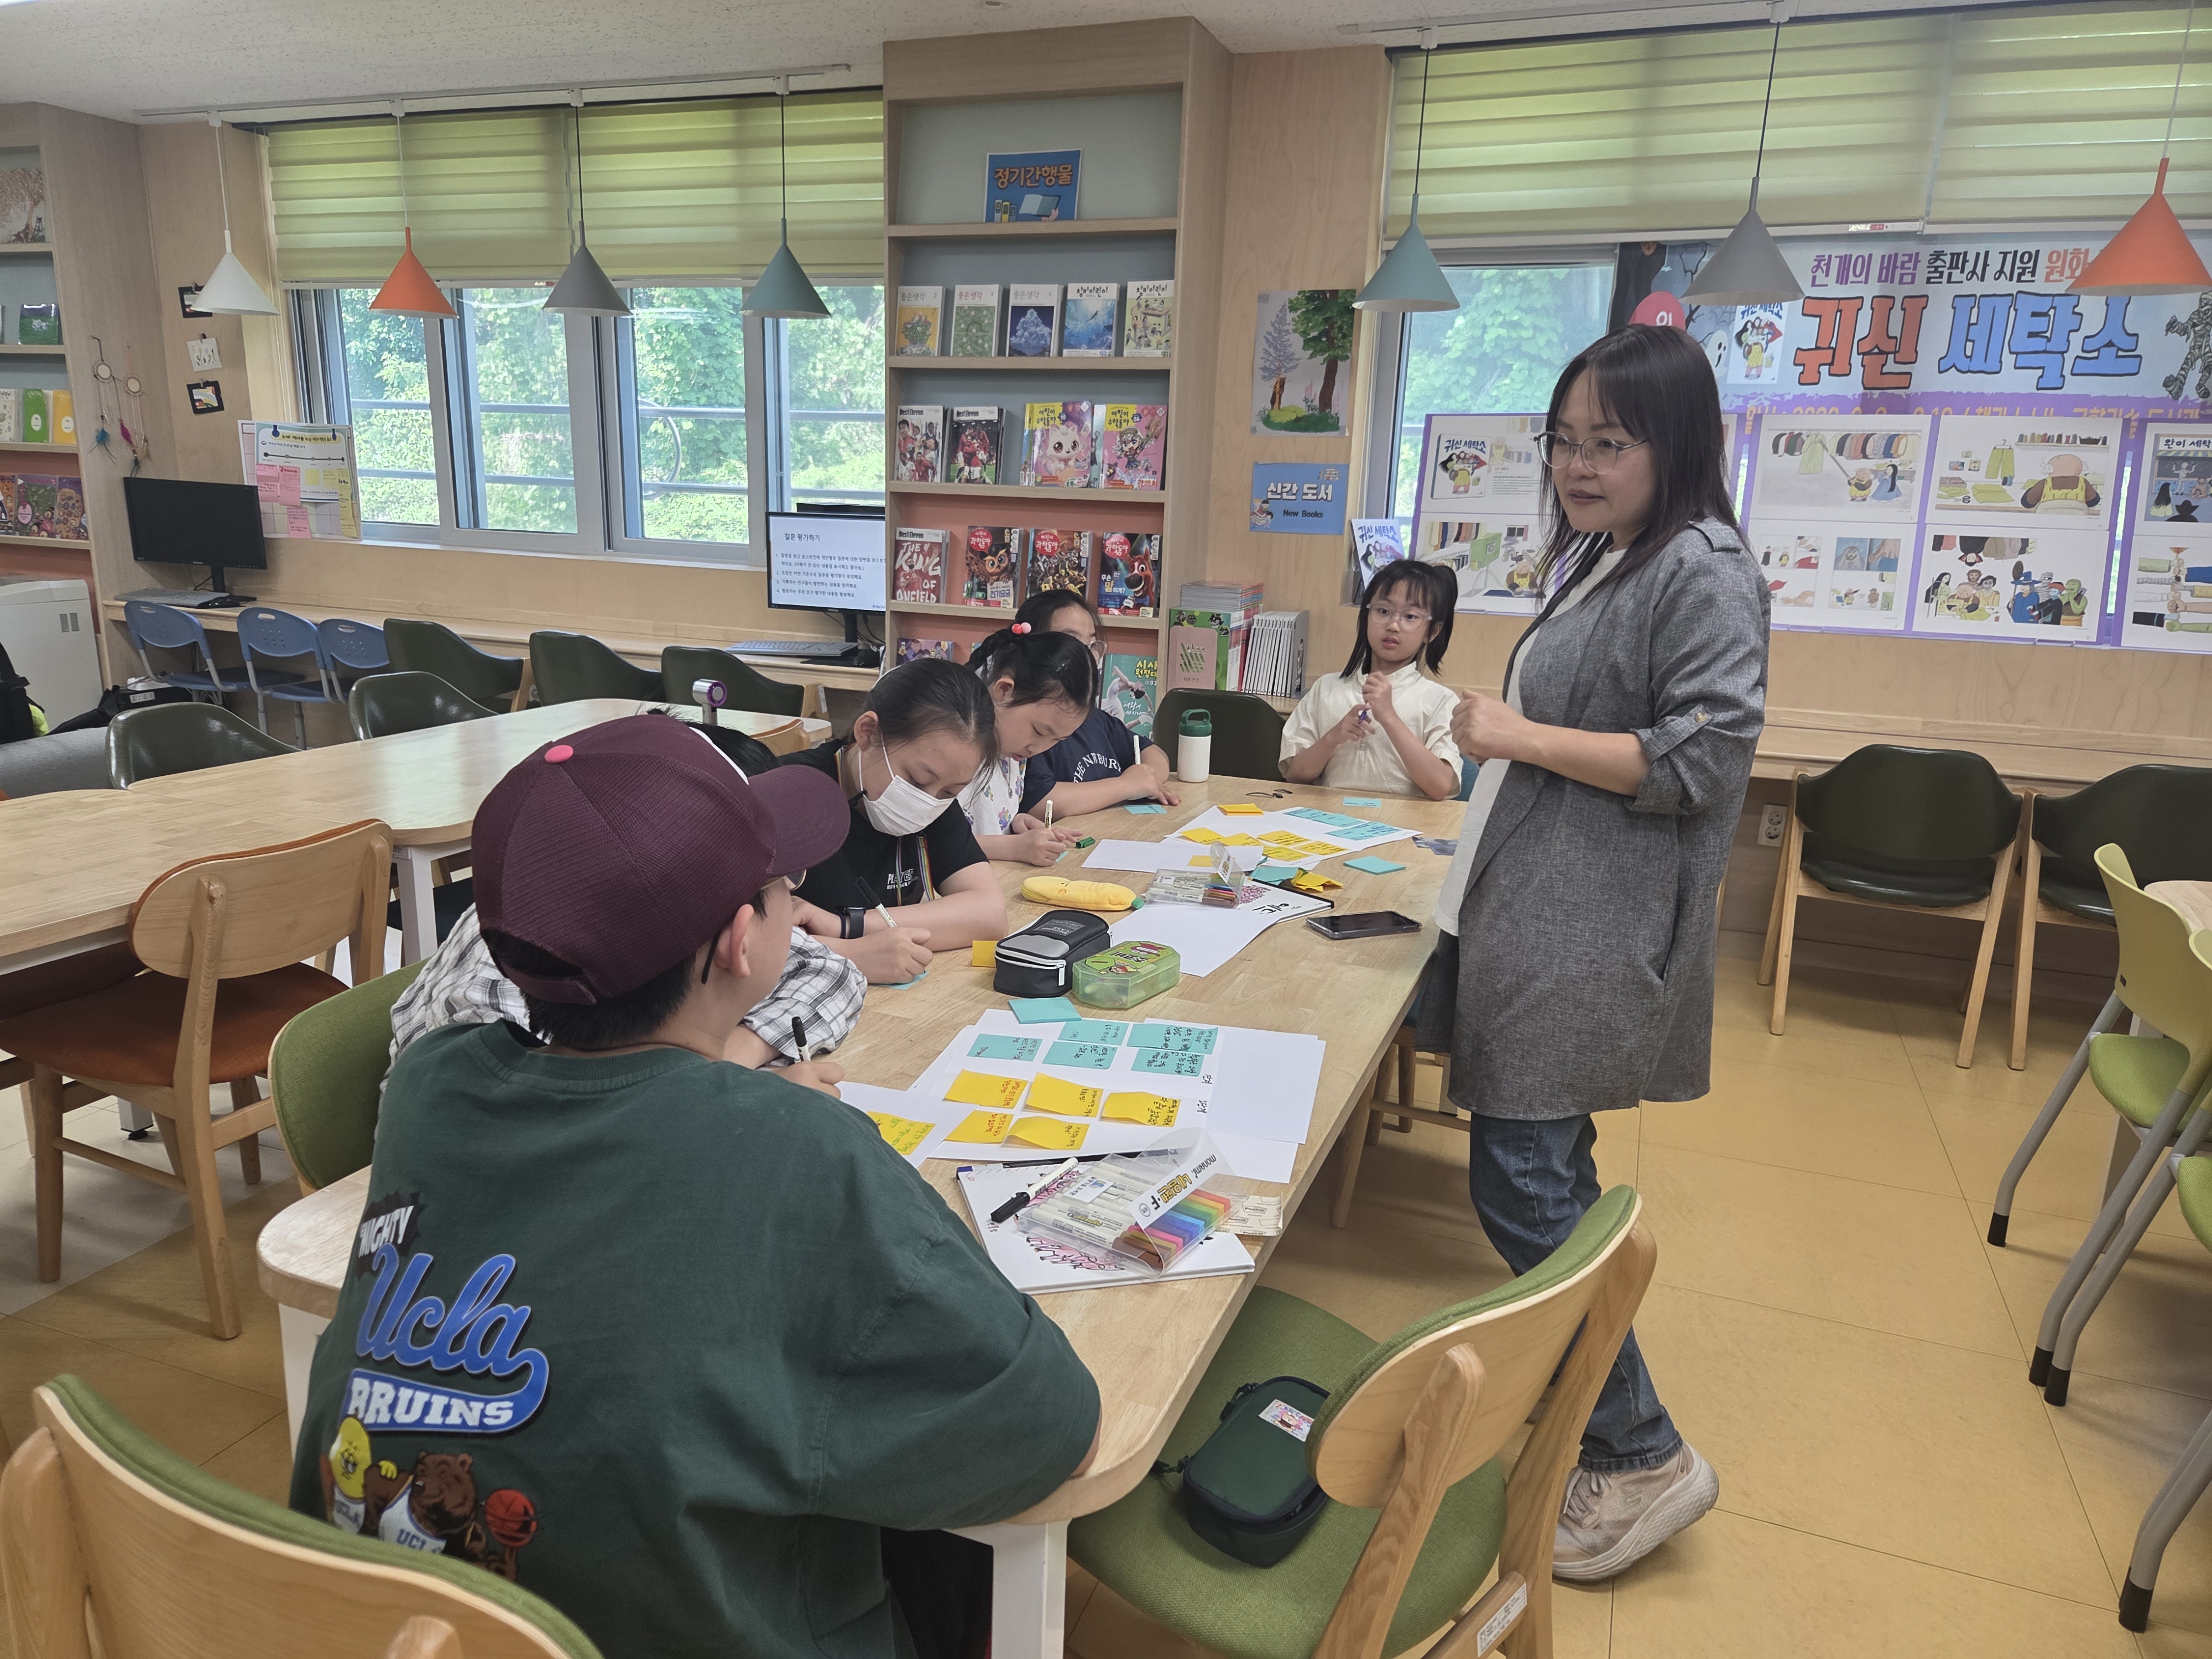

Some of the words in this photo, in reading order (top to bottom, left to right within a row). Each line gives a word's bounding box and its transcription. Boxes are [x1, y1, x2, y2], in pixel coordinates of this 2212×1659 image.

[993, 164, 1073, 189] 정기간행물
[1810, 253, 1872, 288] 천개의
[1876, 252, 1921, 285] 바람
[1926, 250, 1990, 284] 출판사
[1994, 249, 2040, 283] 지원
[2044, 248, 2091, 283] 원화
[958, 291, 982, 301] 좋은생각
[1013, 290, 1040, 301] 좋은생각
[1076, 285, 1108, 298] 창비어린이
[1136, 284, 1167, 297] 창비어린이
[900, 292, 925, 302] 좋은생각
[1793, 294, 1929, 390] 귀신
[1938, 290, 2143, 391] 세탁소
[1038, 409, 1056, 417] 어린이
[1111, 410, 1129, 418] 어린이
[1036, 416, 1057, 427] 수학동아
[1108, 418, 1129, 429] 수학동아
[2164, 438, 2185, 450] 완이
[1267, 481, 1299, 501] 신간
[1302, 483, 1333, 502] 도서
[1283, 509, 1299, 519] New
[1302, 509, 1324, 519] Books
[784, 533, 796, 541] 질문
[797, 534, 820, 542] 평가하기
[1358, 525, 1374, 544] 귀신
[1374, 524, 1400, 544] 세탁소
[901, 542, 922, 552] THE
[970, 536, 991, 549] 과학동아
[1035, 541, 1058, 553] 과학동아
[1105, 544, 1129, 556] 과학동아
[922, 579, 937, 589] OF
[358, 1205, 415, 1259] MIGHTY
[347, 1376, 515, 1428] BRUINS
